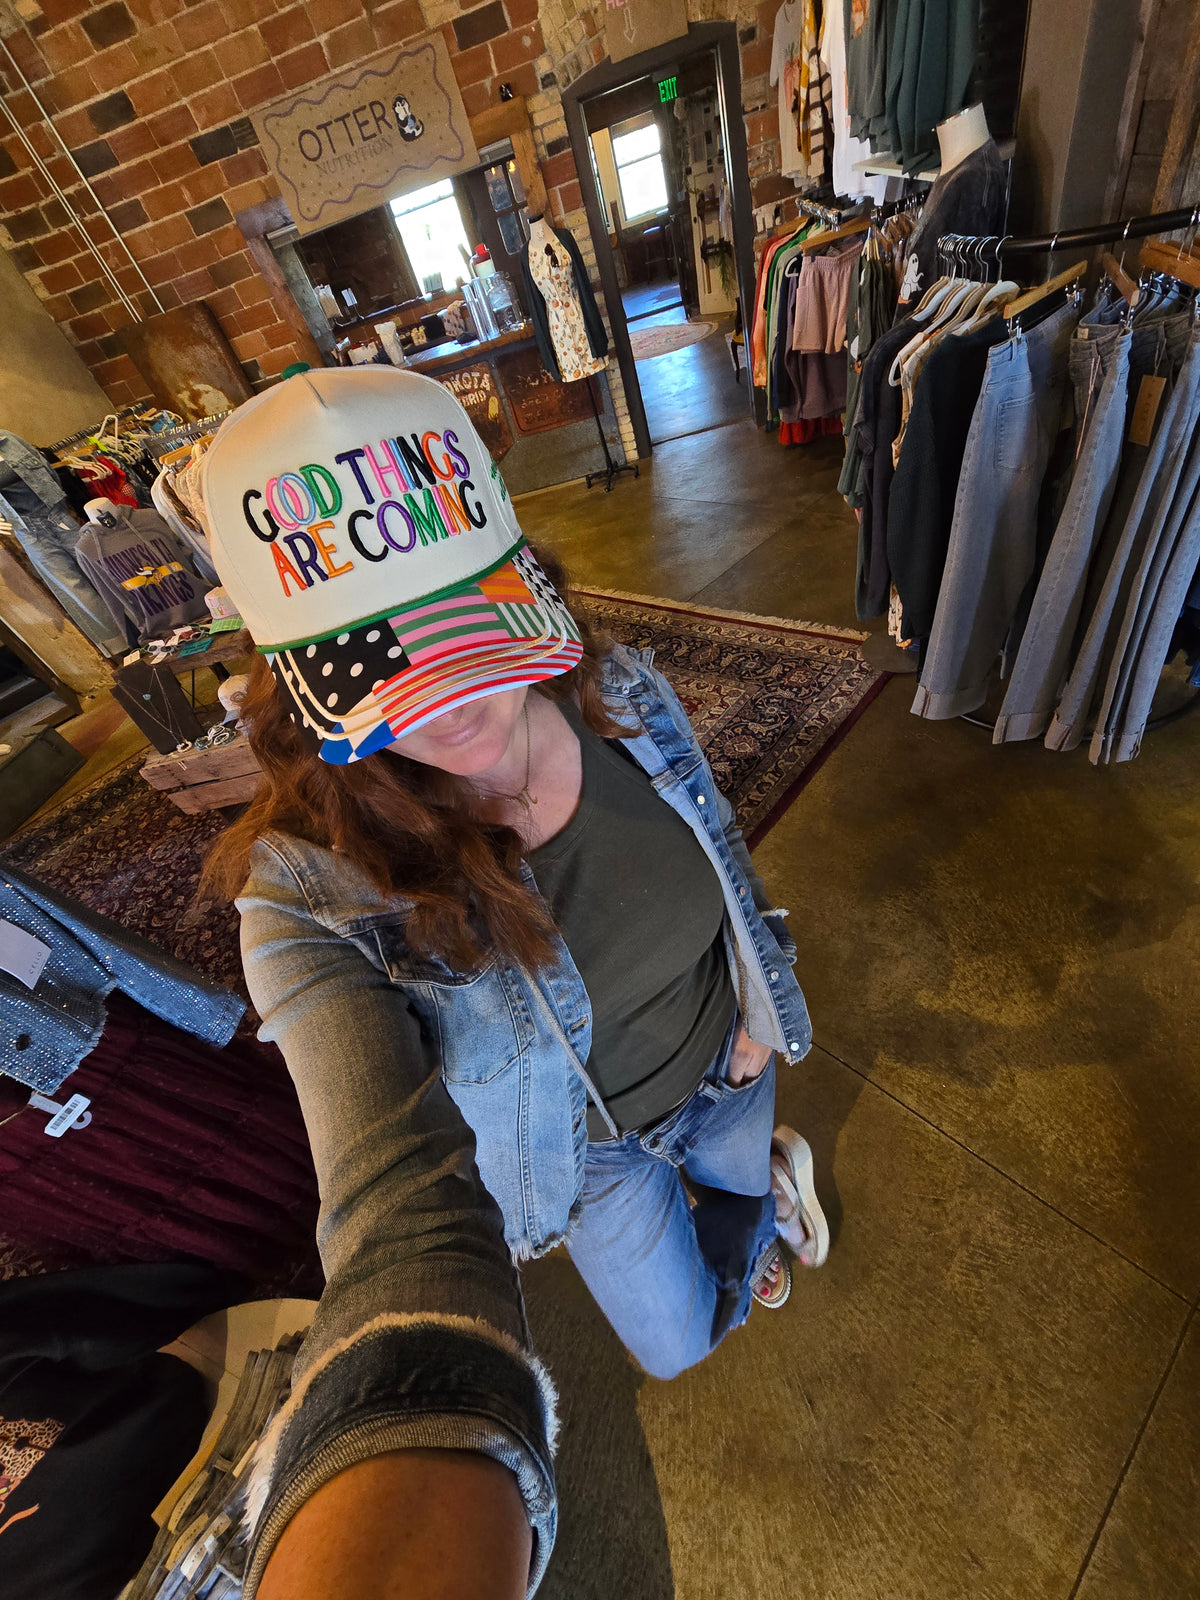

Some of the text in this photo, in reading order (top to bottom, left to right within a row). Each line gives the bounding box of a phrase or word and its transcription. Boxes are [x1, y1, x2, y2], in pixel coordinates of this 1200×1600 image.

[658, 76, 678, 103] EXIT
[298, 100, 393, 162] OTTER
[315, 135, 394, 176] NUTRITION
[242, 463, 343, 542] GOOD
[334, 429, 471, 505] THINGS
[270, 520, 355, 597] ARE
[347, 479, 487, 562] COMING
